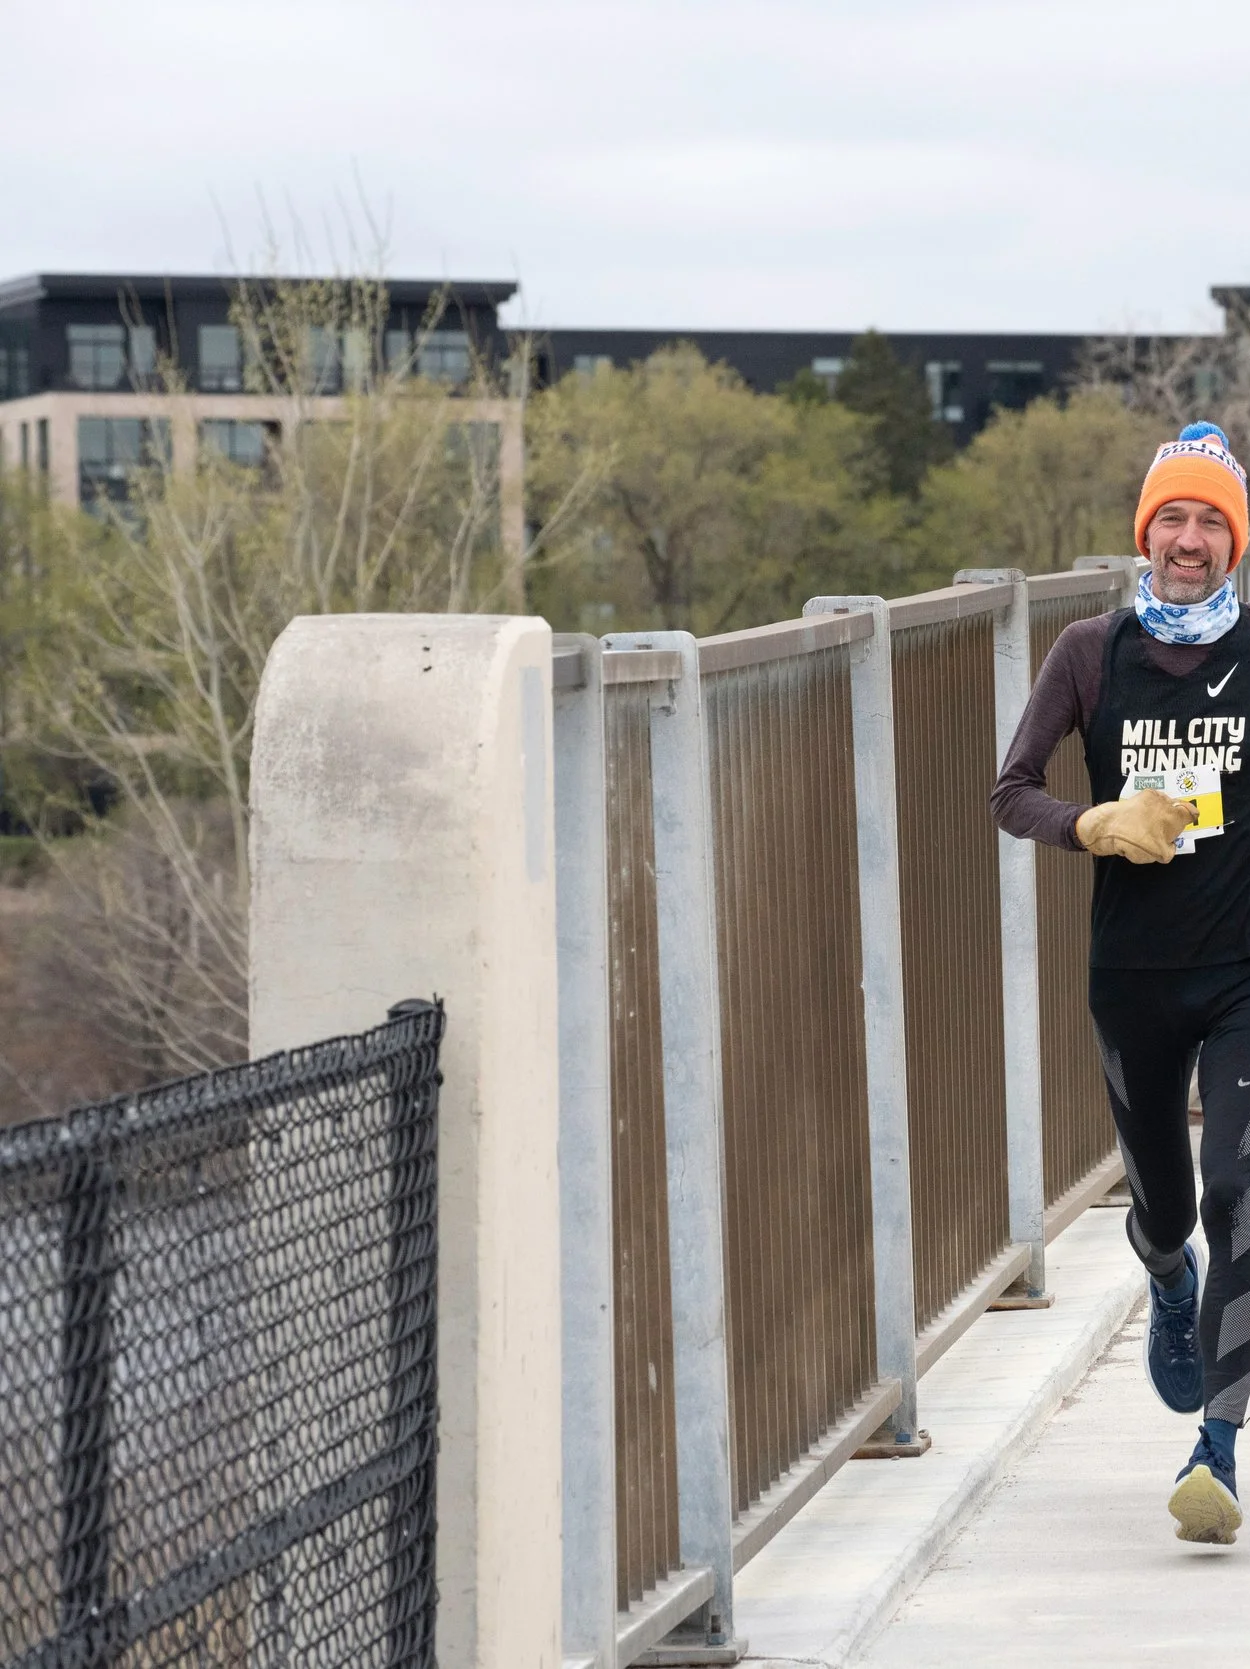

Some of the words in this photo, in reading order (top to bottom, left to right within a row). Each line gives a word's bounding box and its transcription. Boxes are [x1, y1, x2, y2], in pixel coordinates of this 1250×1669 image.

[1121, 719, 1183, 746] MILL
[1187, 716, 1246, 744] CITY
[1120, 745, 1242, 777] RUNNING
